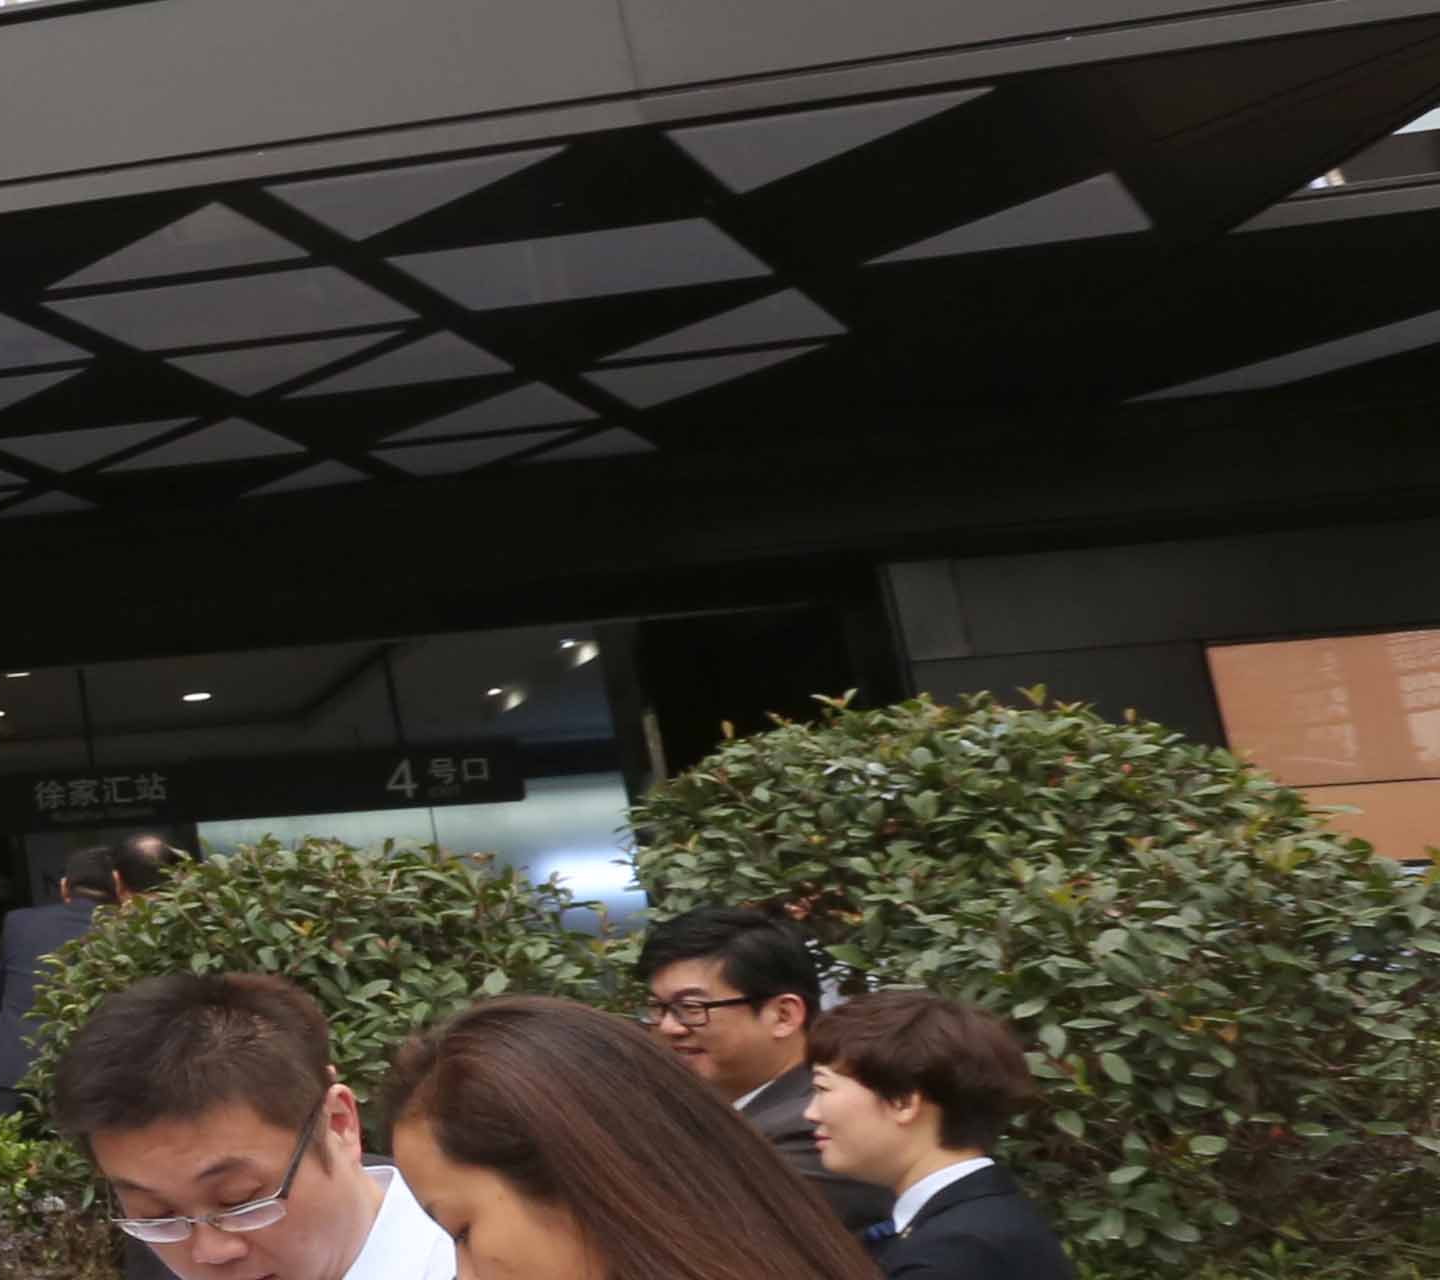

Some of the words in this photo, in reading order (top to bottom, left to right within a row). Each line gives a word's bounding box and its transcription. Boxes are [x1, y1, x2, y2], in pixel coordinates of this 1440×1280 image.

[33, 771, 169, 811] 徐家汇站
[385, 756, 419, 798] 4
